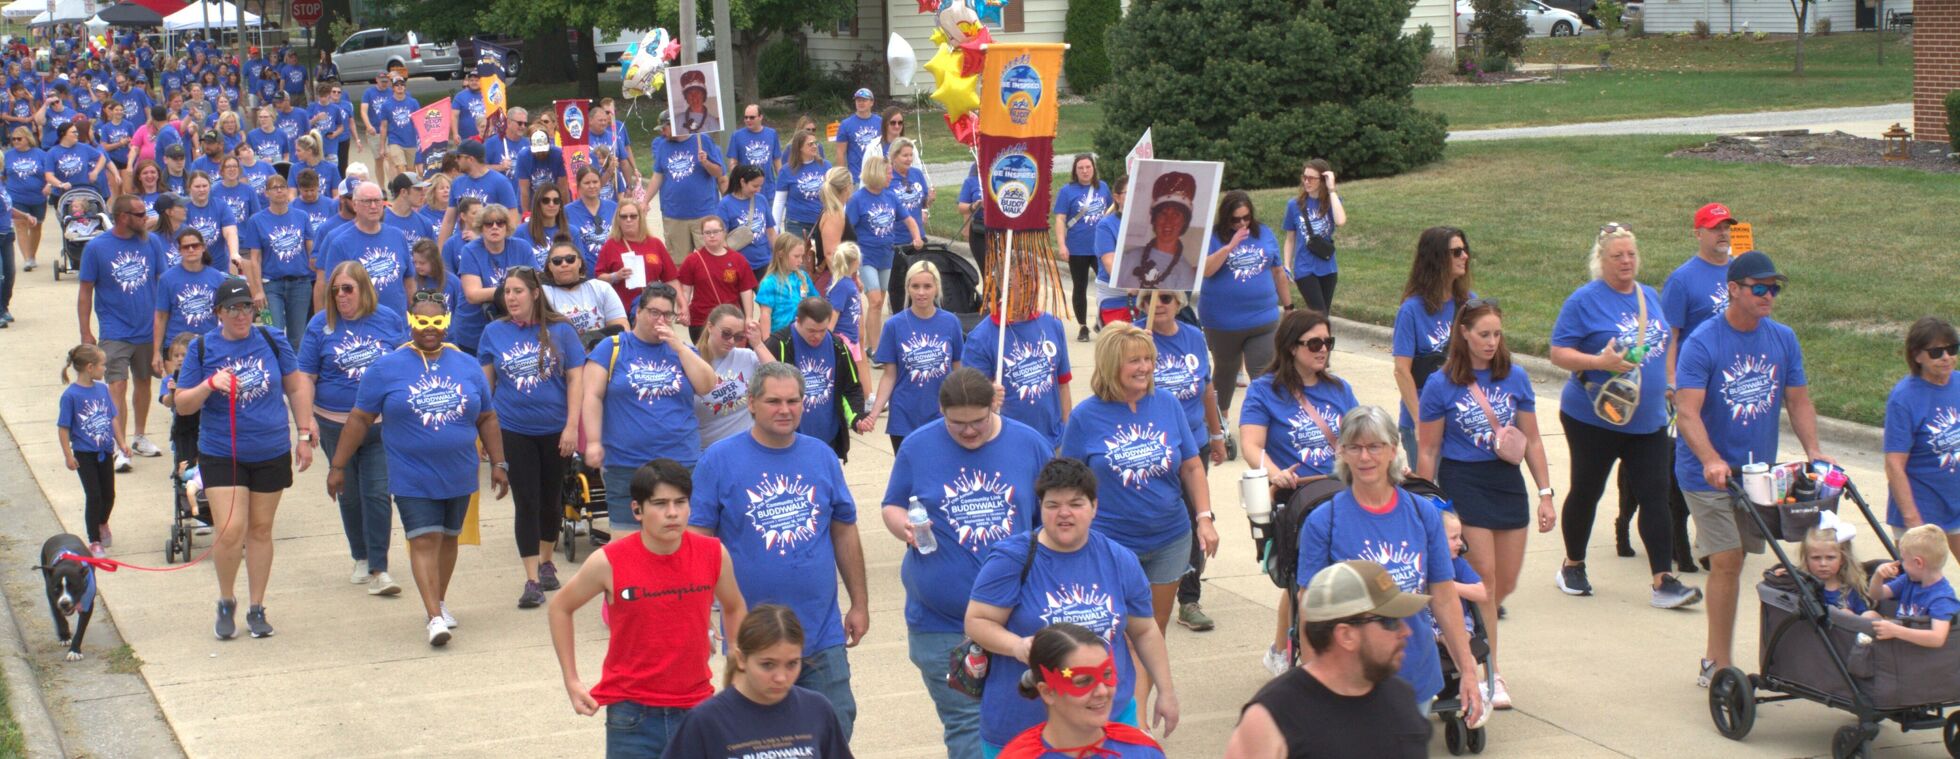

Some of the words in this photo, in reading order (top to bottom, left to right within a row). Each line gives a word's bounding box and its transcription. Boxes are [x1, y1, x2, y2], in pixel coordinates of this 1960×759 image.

[293, 3, 321, 17] STOP
[1004, 171, 1036, 179] INSPIRED
[1000, 199, 1025, 207] BUDDY
[1002, 205, 1022, 214] WALK
[711, 381, 738, 399] SUPER
[416, 393, 457, 405] BUDDYWALK
[1464, 406, 1508, 425] BUDDYALK
[1114, 443, 1162, 460] BUDDYWALK
[766, 498, 794, 508] Community
[951, 500, 1005, 513] BUDDYWALK
[960, 496, 990, 504] Community
[757, 500, 808, 518] BUDDYWALK
[620, 584, 712, 601] Champion
[1052, 609, 1108, 624] BUDDYWALK
